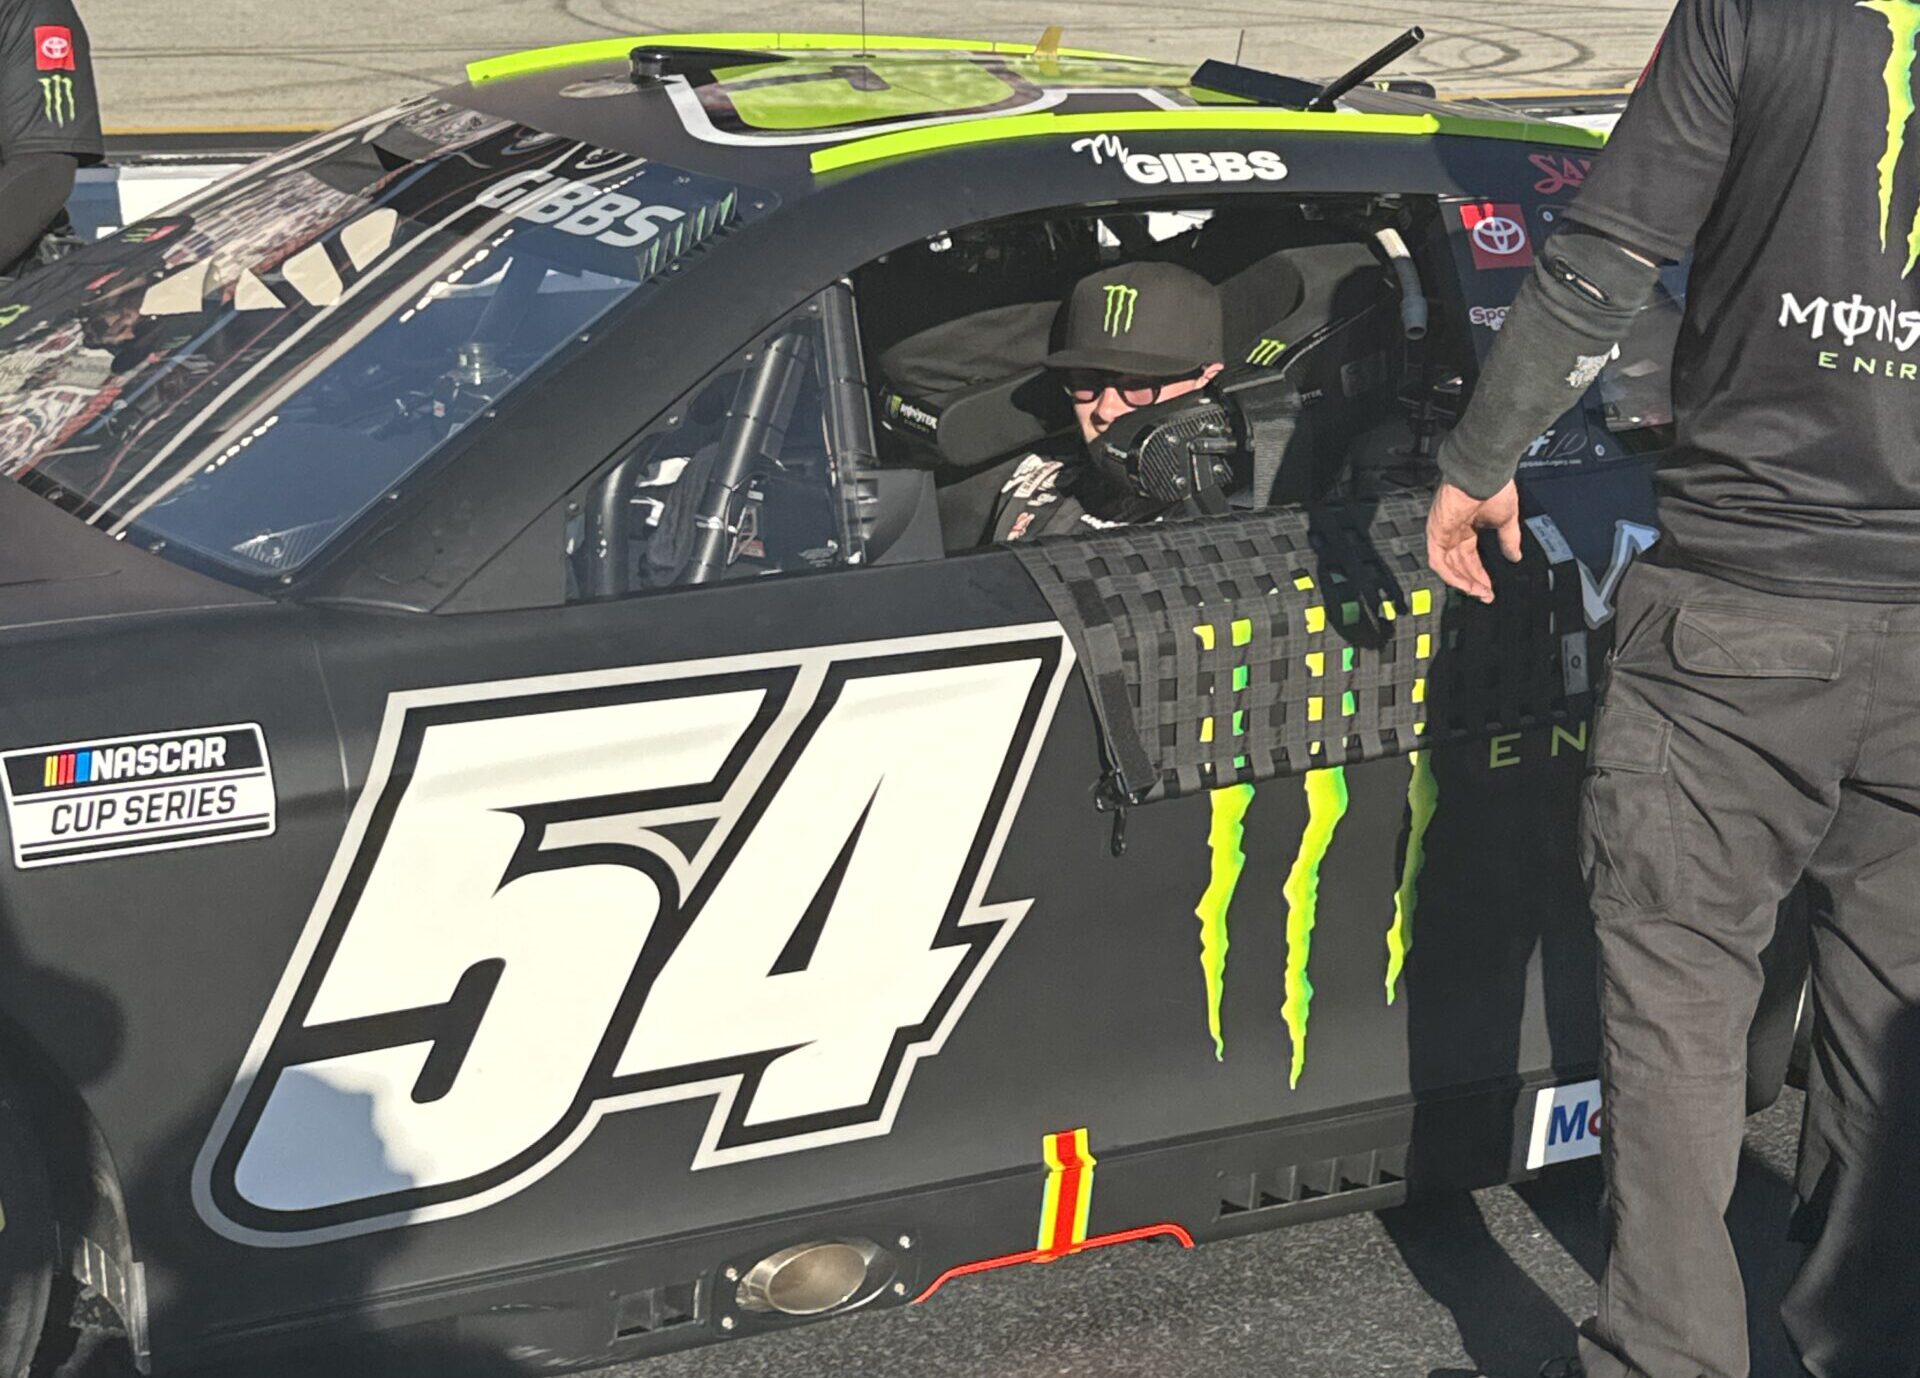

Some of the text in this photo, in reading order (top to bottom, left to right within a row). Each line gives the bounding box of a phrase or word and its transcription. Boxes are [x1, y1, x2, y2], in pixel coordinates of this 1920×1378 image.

[1122, 150, 1288, 184] GIBBS
[1528, 153, 1592, 194] SA
[475, 169, 686, 248] GIBBS
[1818, 351, 1918, 380] ENER
[90, 736, 227, 781] NASCAR
[51, 784, 238, 836] CUP SERIES
[198, 626, 1070, 1238] 54
